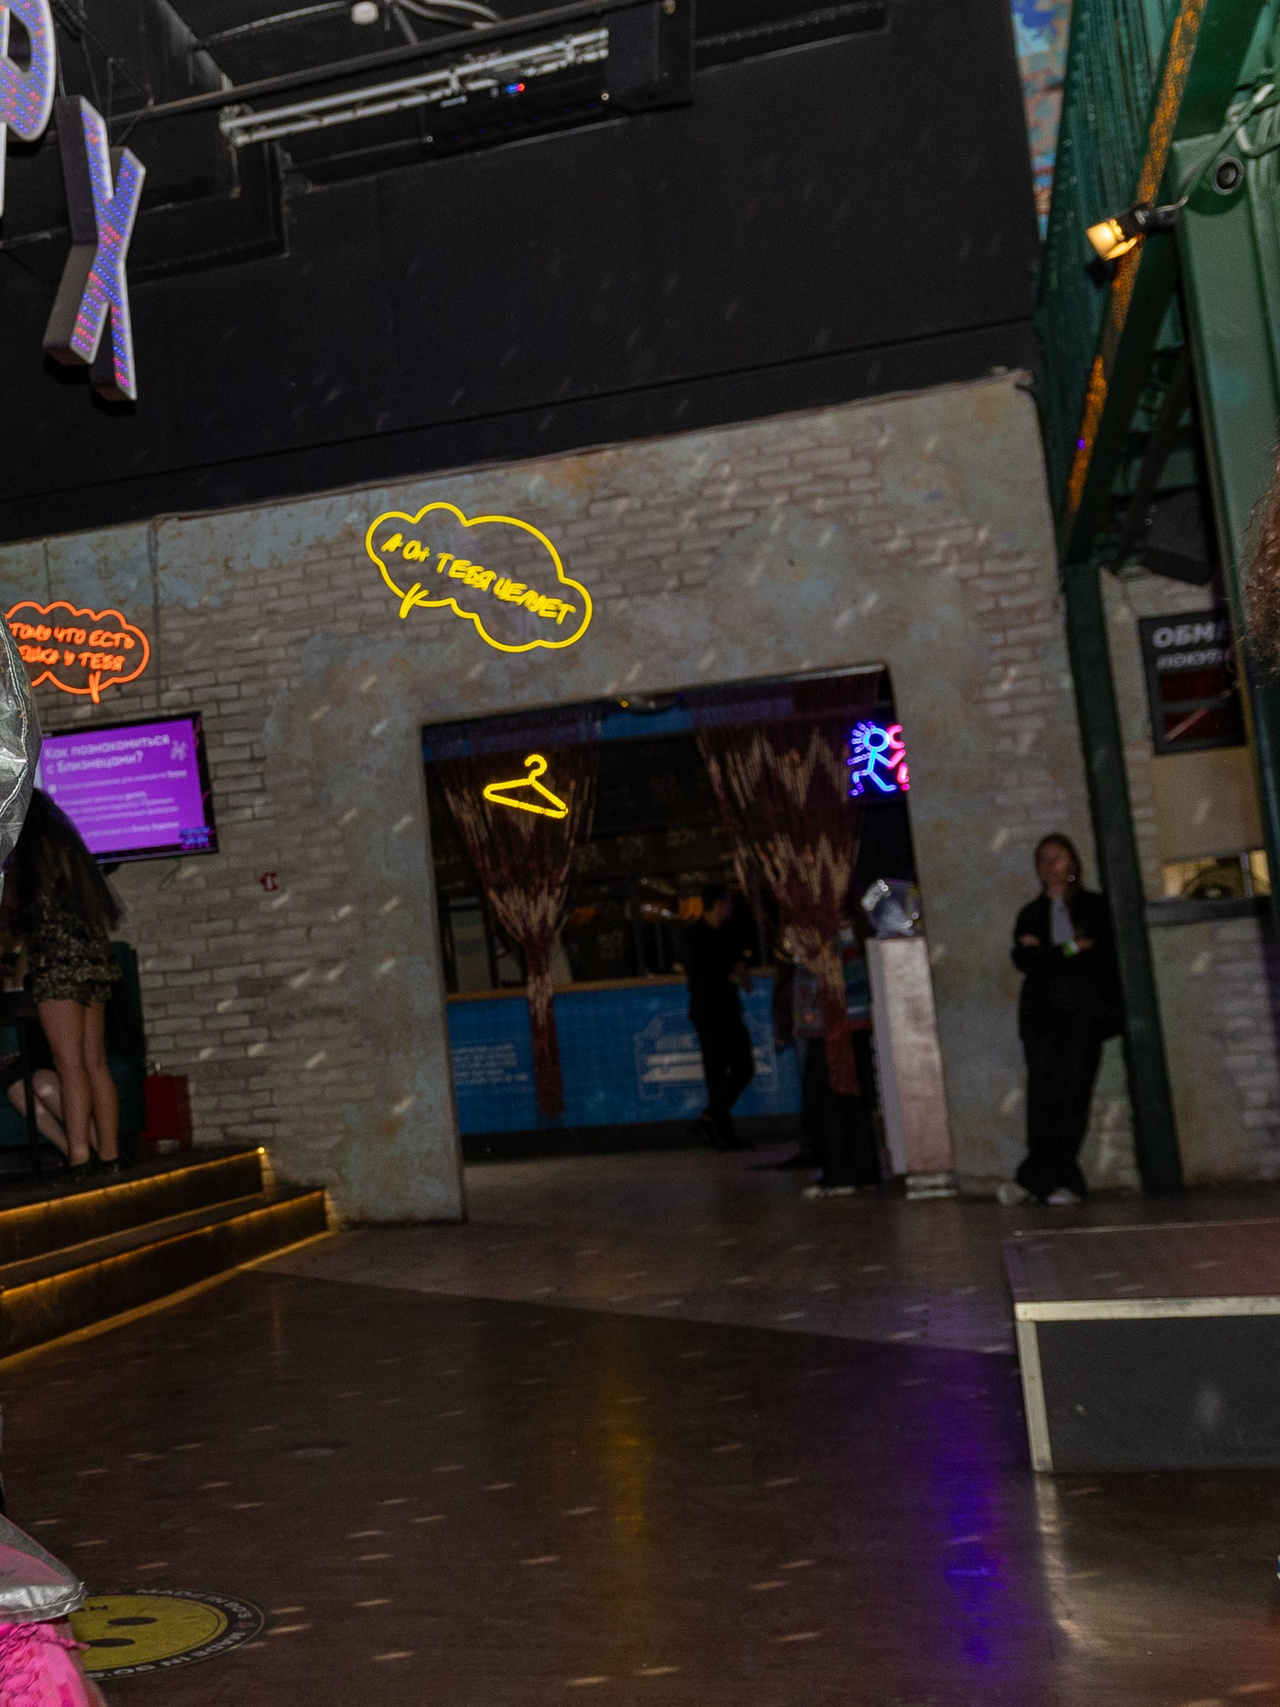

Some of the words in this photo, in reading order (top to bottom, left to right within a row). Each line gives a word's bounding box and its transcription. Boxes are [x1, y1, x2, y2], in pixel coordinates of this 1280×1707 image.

[436, 552, 497, 592] ТЕБЯ
[493, 576, 577, 625] ЦЕЛУЕТ
[53, 626, 87, 645] ЧТО
[88, 629, 136, 650] ЕСТЬ
[78, 651, 126, 672] ТЕБЯ
[71, 734, 170, 758] познакомиться
